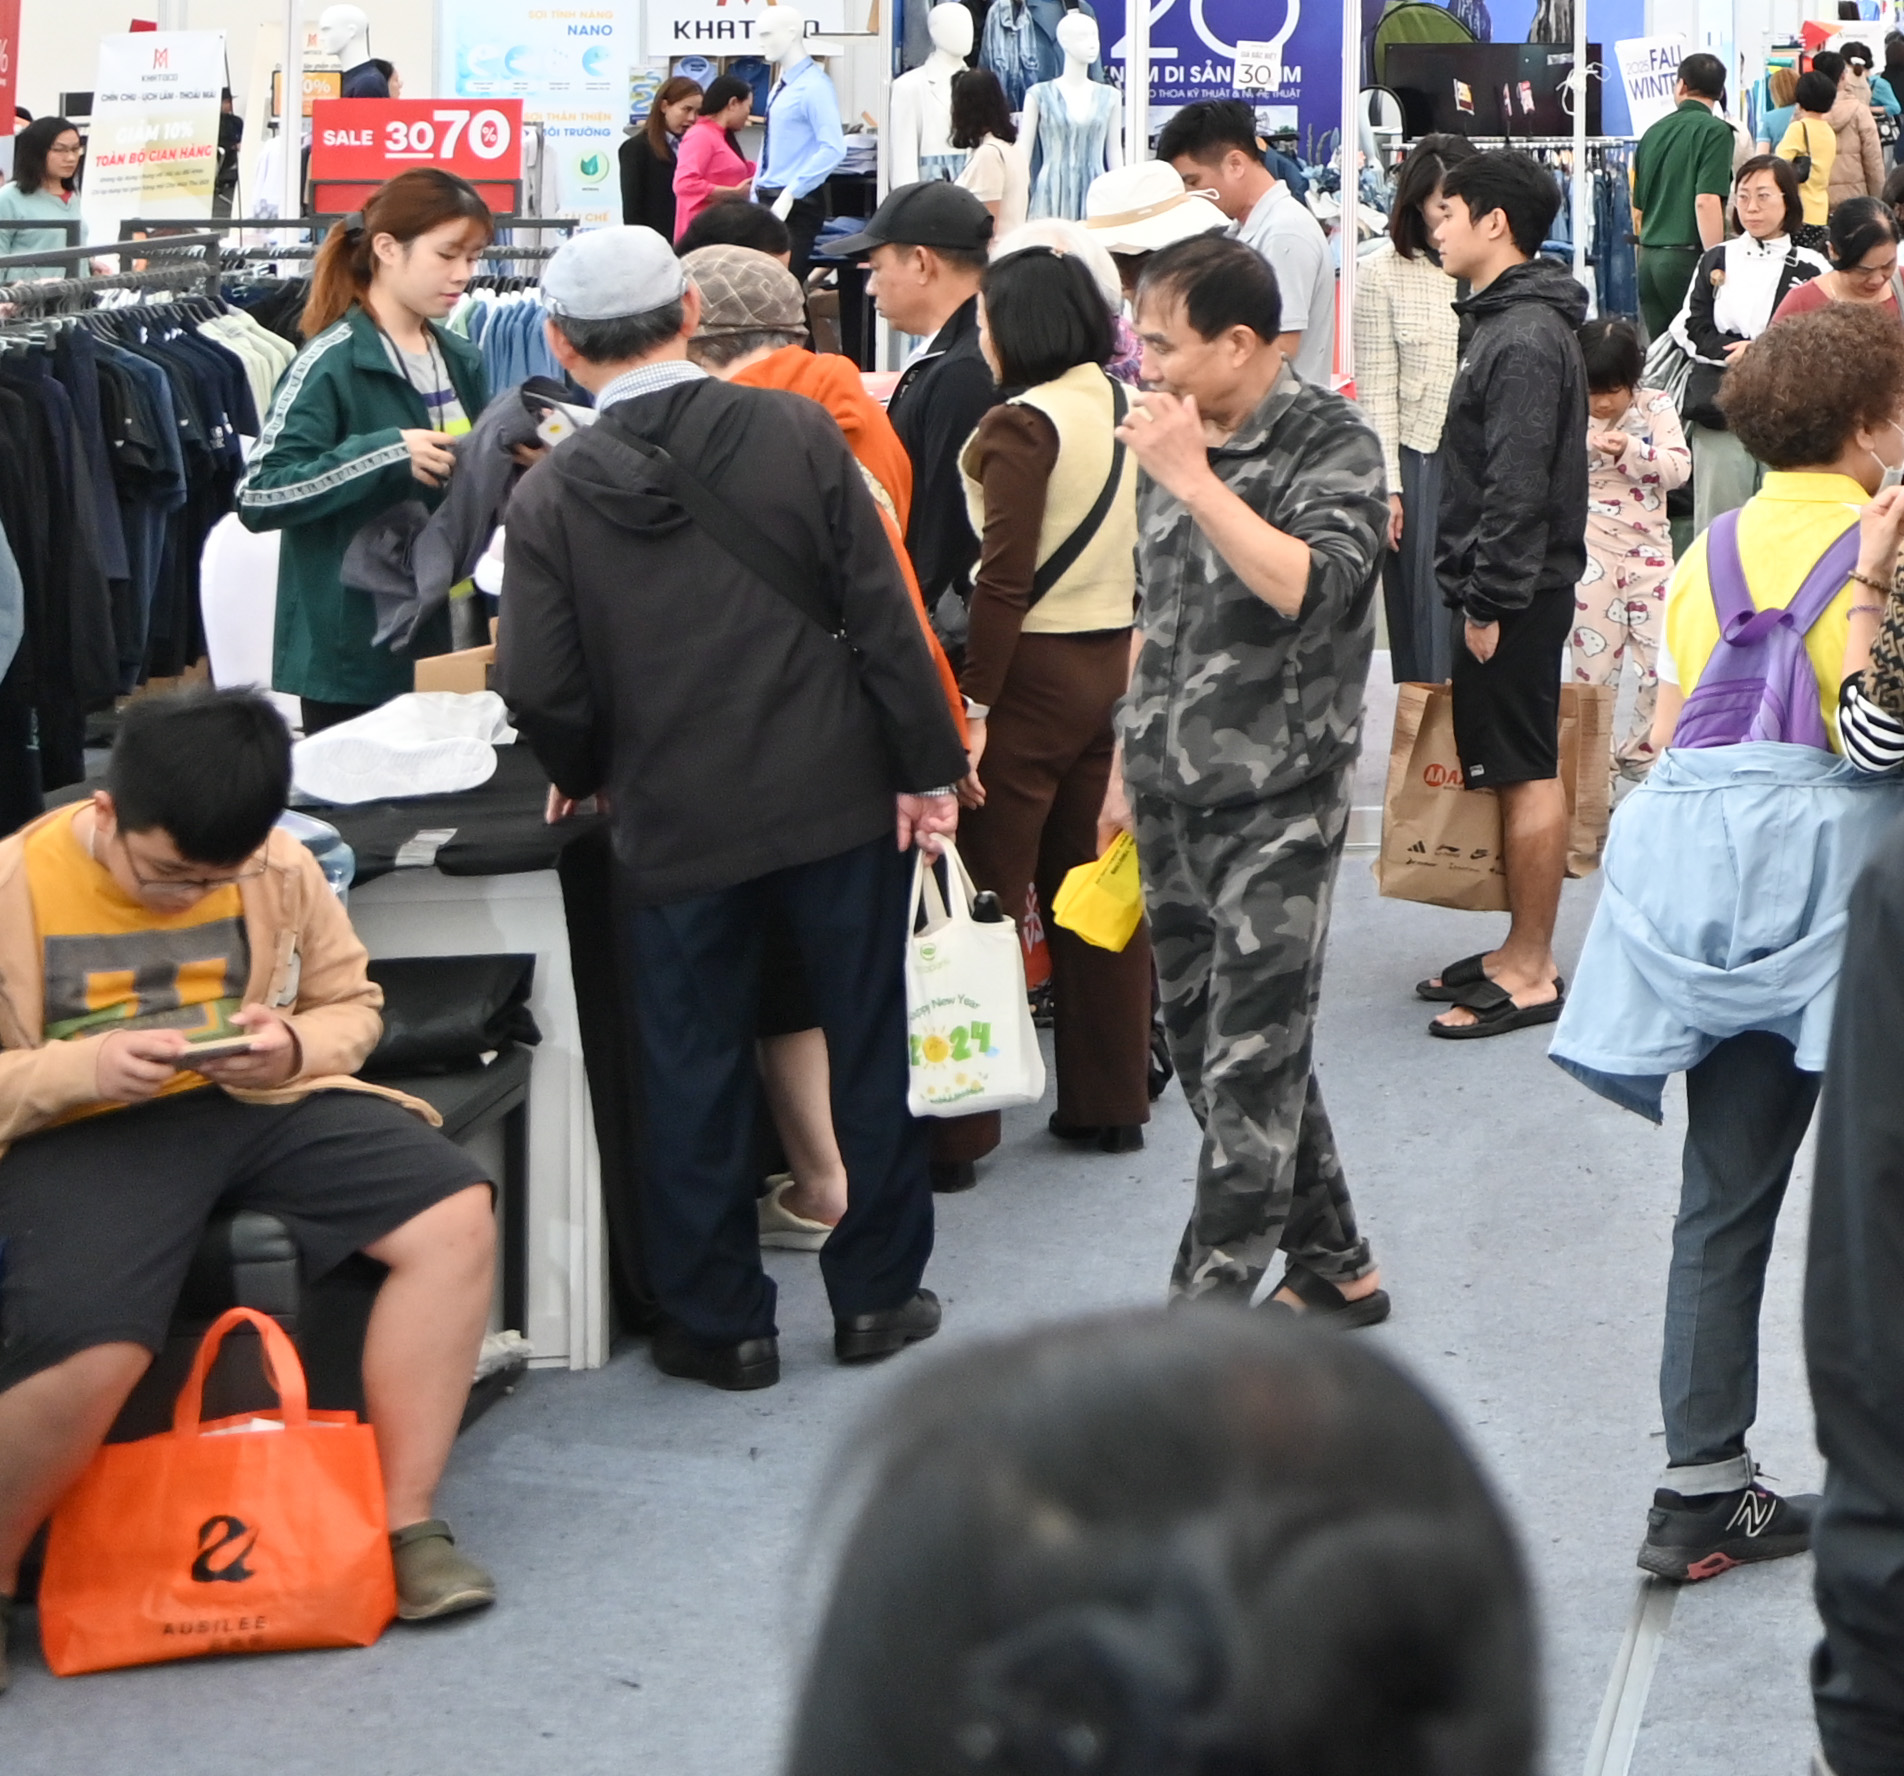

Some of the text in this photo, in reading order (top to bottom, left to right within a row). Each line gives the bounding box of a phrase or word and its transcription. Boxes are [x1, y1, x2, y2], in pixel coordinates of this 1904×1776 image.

[567, 25, 613, 36] NANO
[1649, 44, 1682, 72] FALL
[1165, 59, 1231, 83] DI SẢN
[323, 129, 374, 146] SALE
[96, 142, 213, 167] TOÀN BỘ GIAN HÀNG
[931, 993, 981, 1011] New Year
